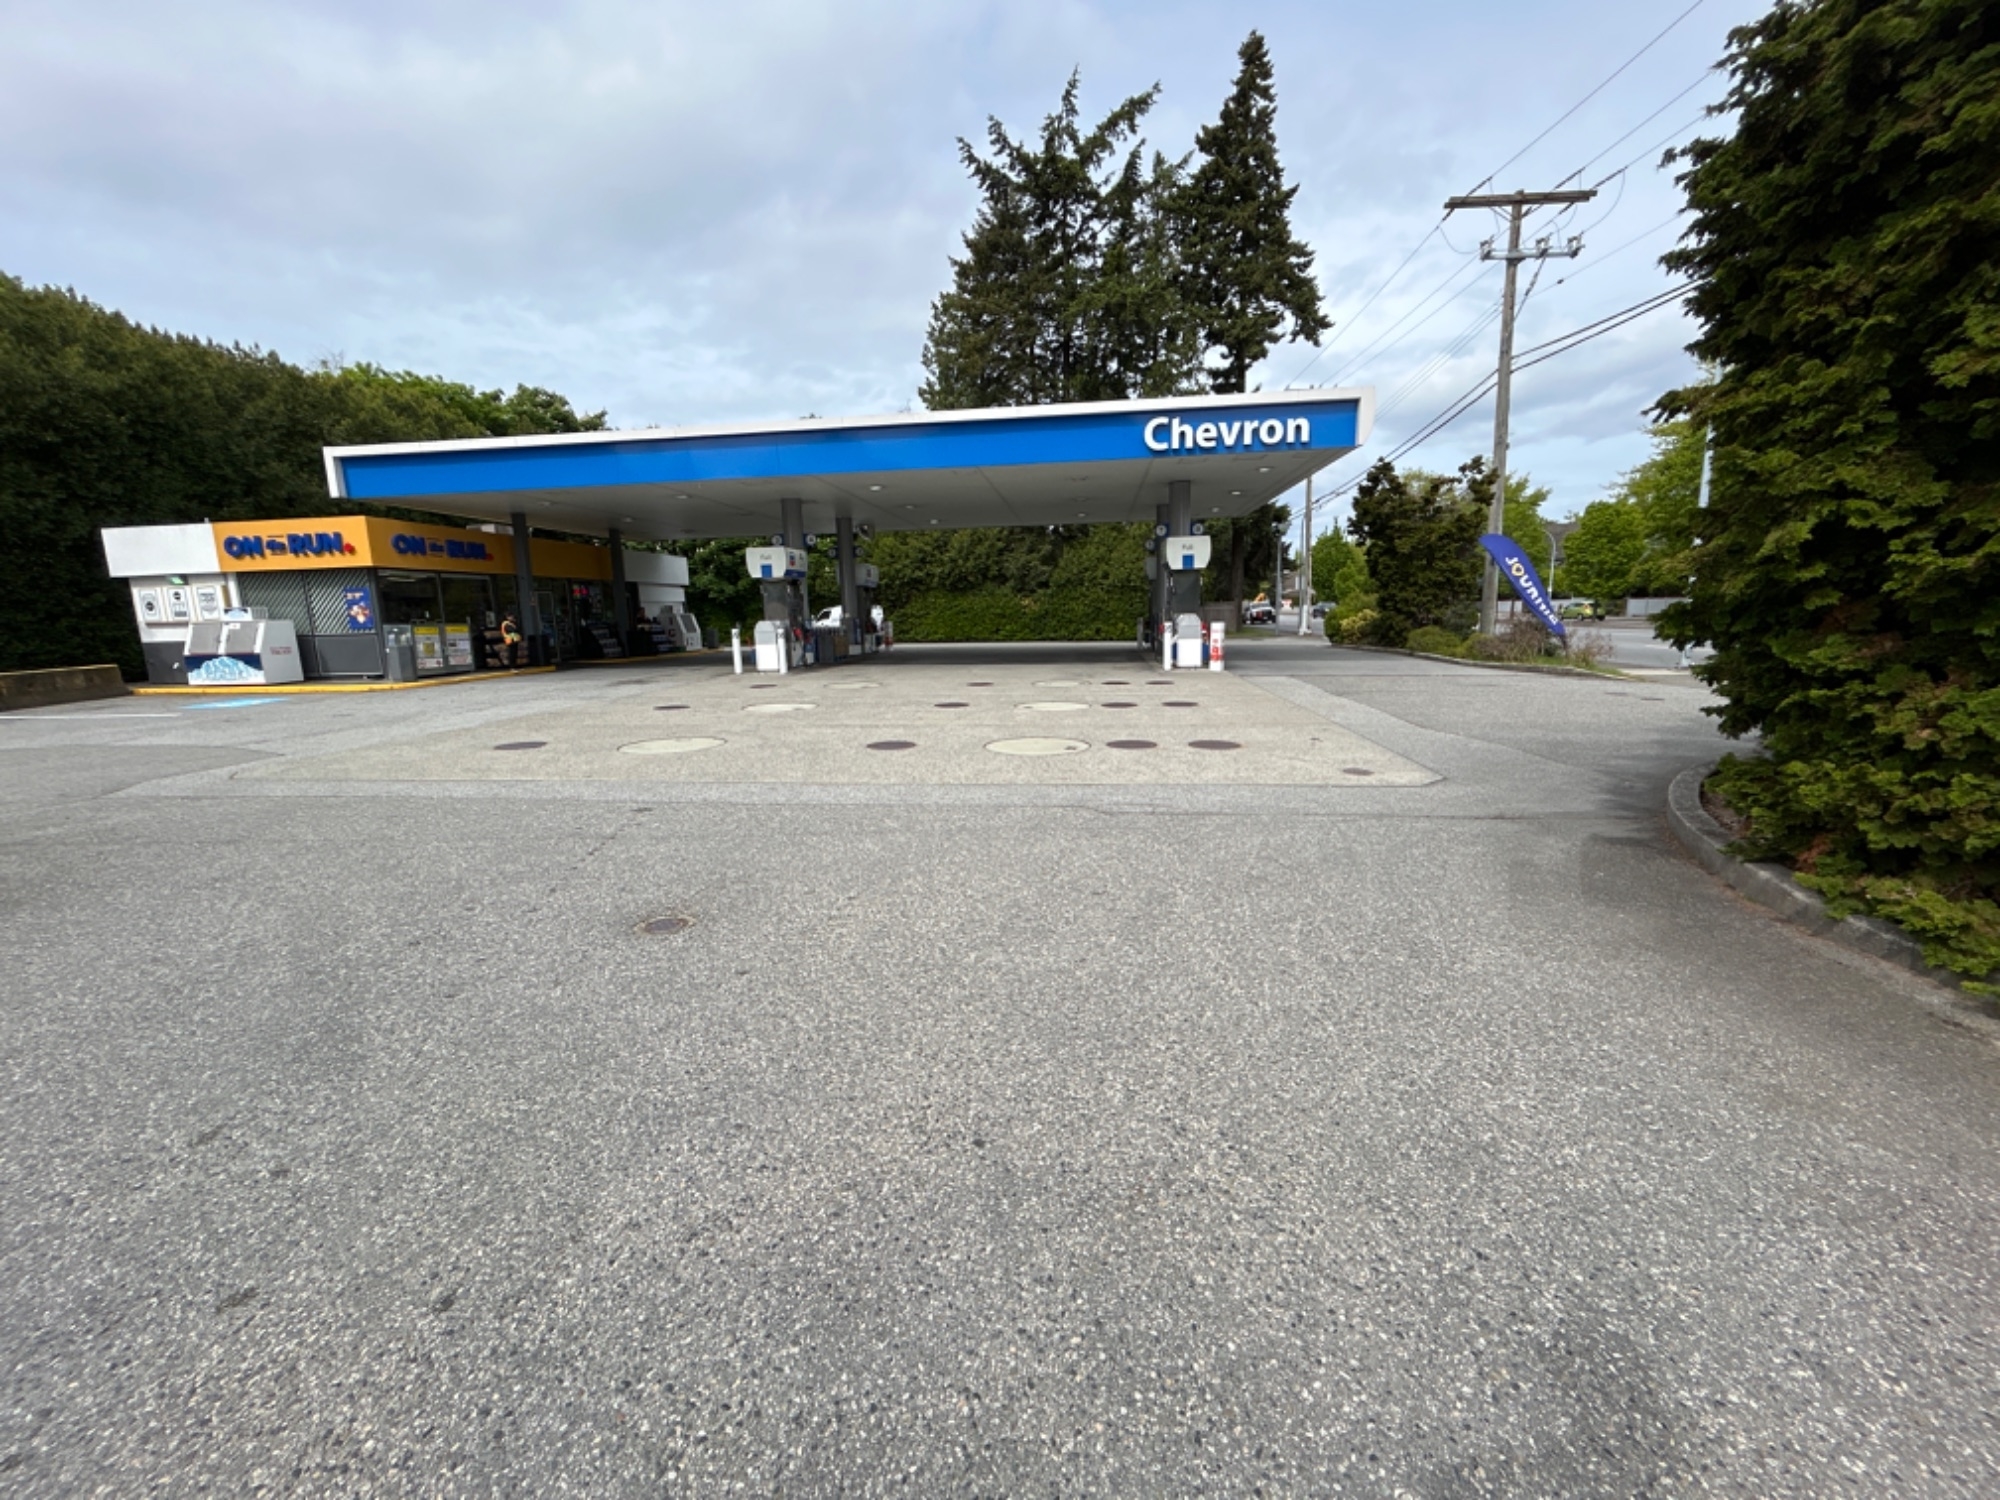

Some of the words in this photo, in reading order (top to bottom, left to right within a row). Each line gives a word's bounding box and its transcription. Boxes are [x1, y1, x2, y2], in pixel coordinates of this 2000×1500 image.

[1144, 416, 1310, 451] Chevron
[223, 535, 263, 557] ON
[286, 532, 343, 555] RUN
[391, 533, 427, 555] ON
